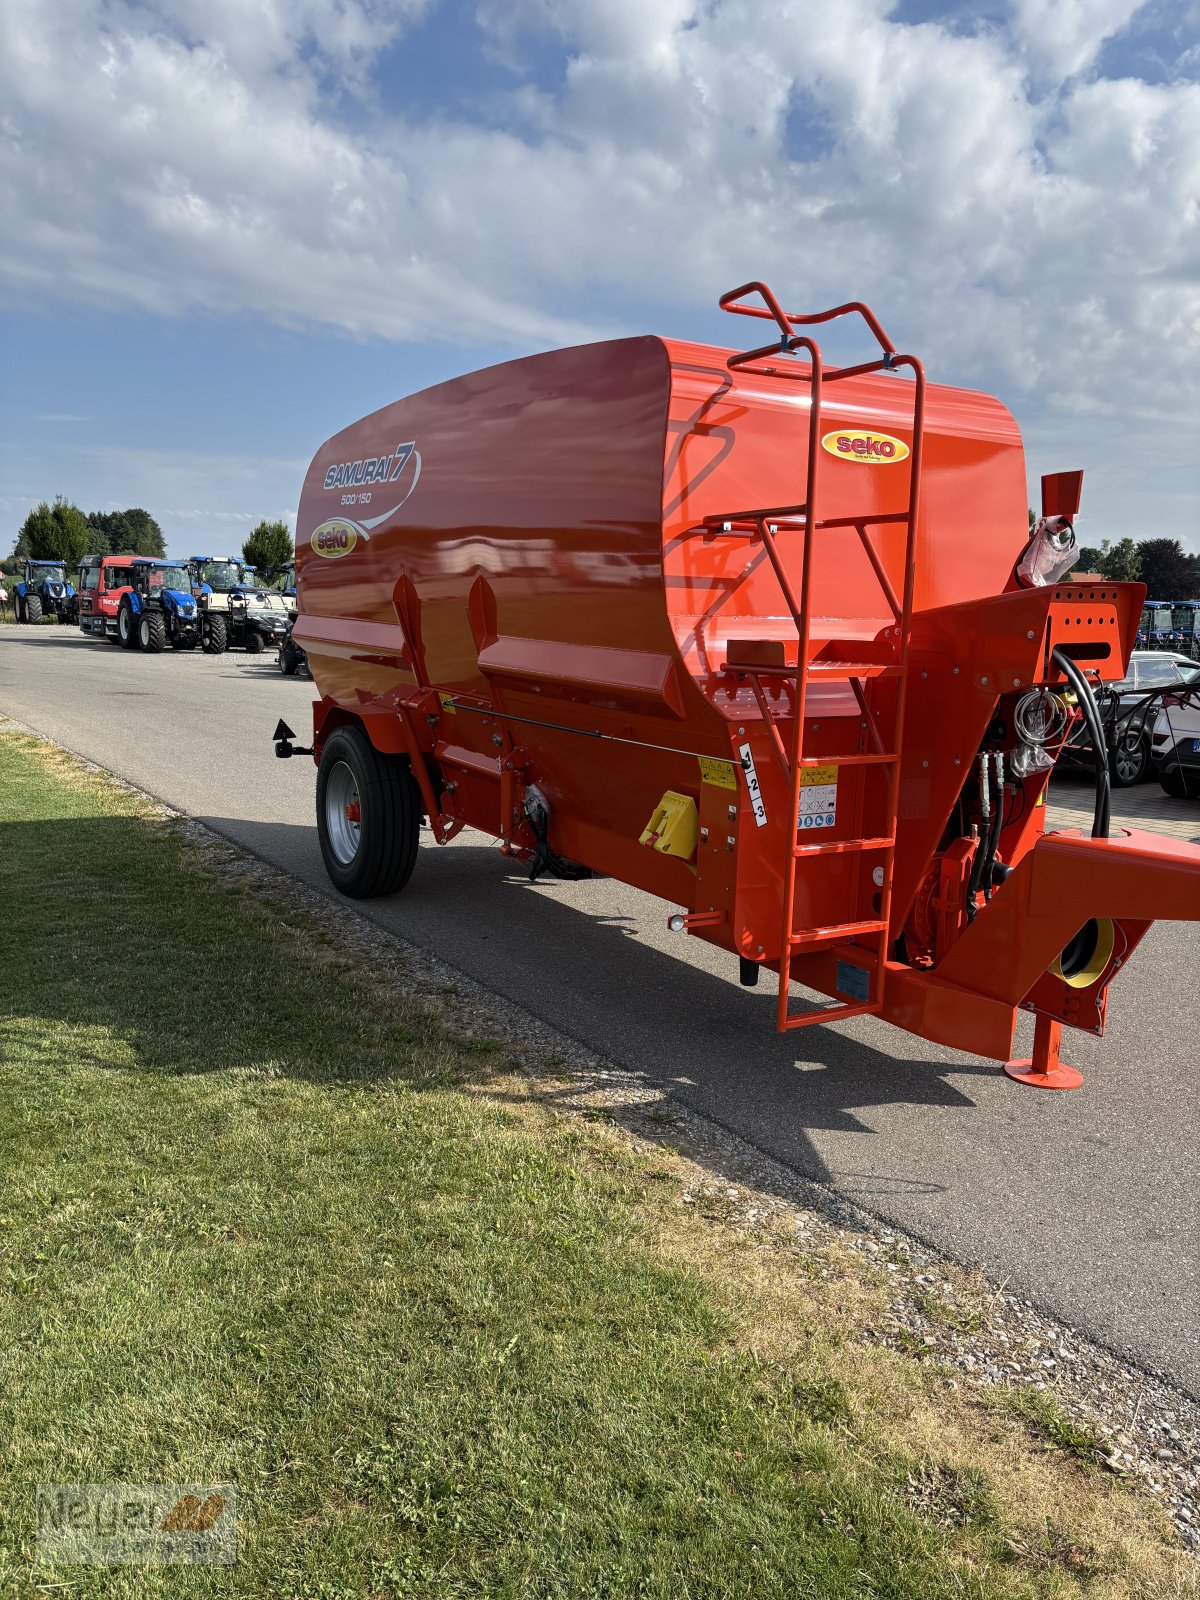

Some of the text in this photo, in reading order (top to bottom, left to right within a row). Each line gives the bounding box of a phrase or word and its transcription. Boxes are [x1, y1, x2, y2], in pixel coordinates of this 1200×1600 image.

[836, 436, 896, 458] seko
[323, 441, 416, 490] SAMURAI 7
[340, 492, 371, 505] 500/150
[317, 527, 349, 549] seko
[745, 751, 751, 763] 1
[751, 778, 758, 791] 2
[757, 805, 764, 818] 3
